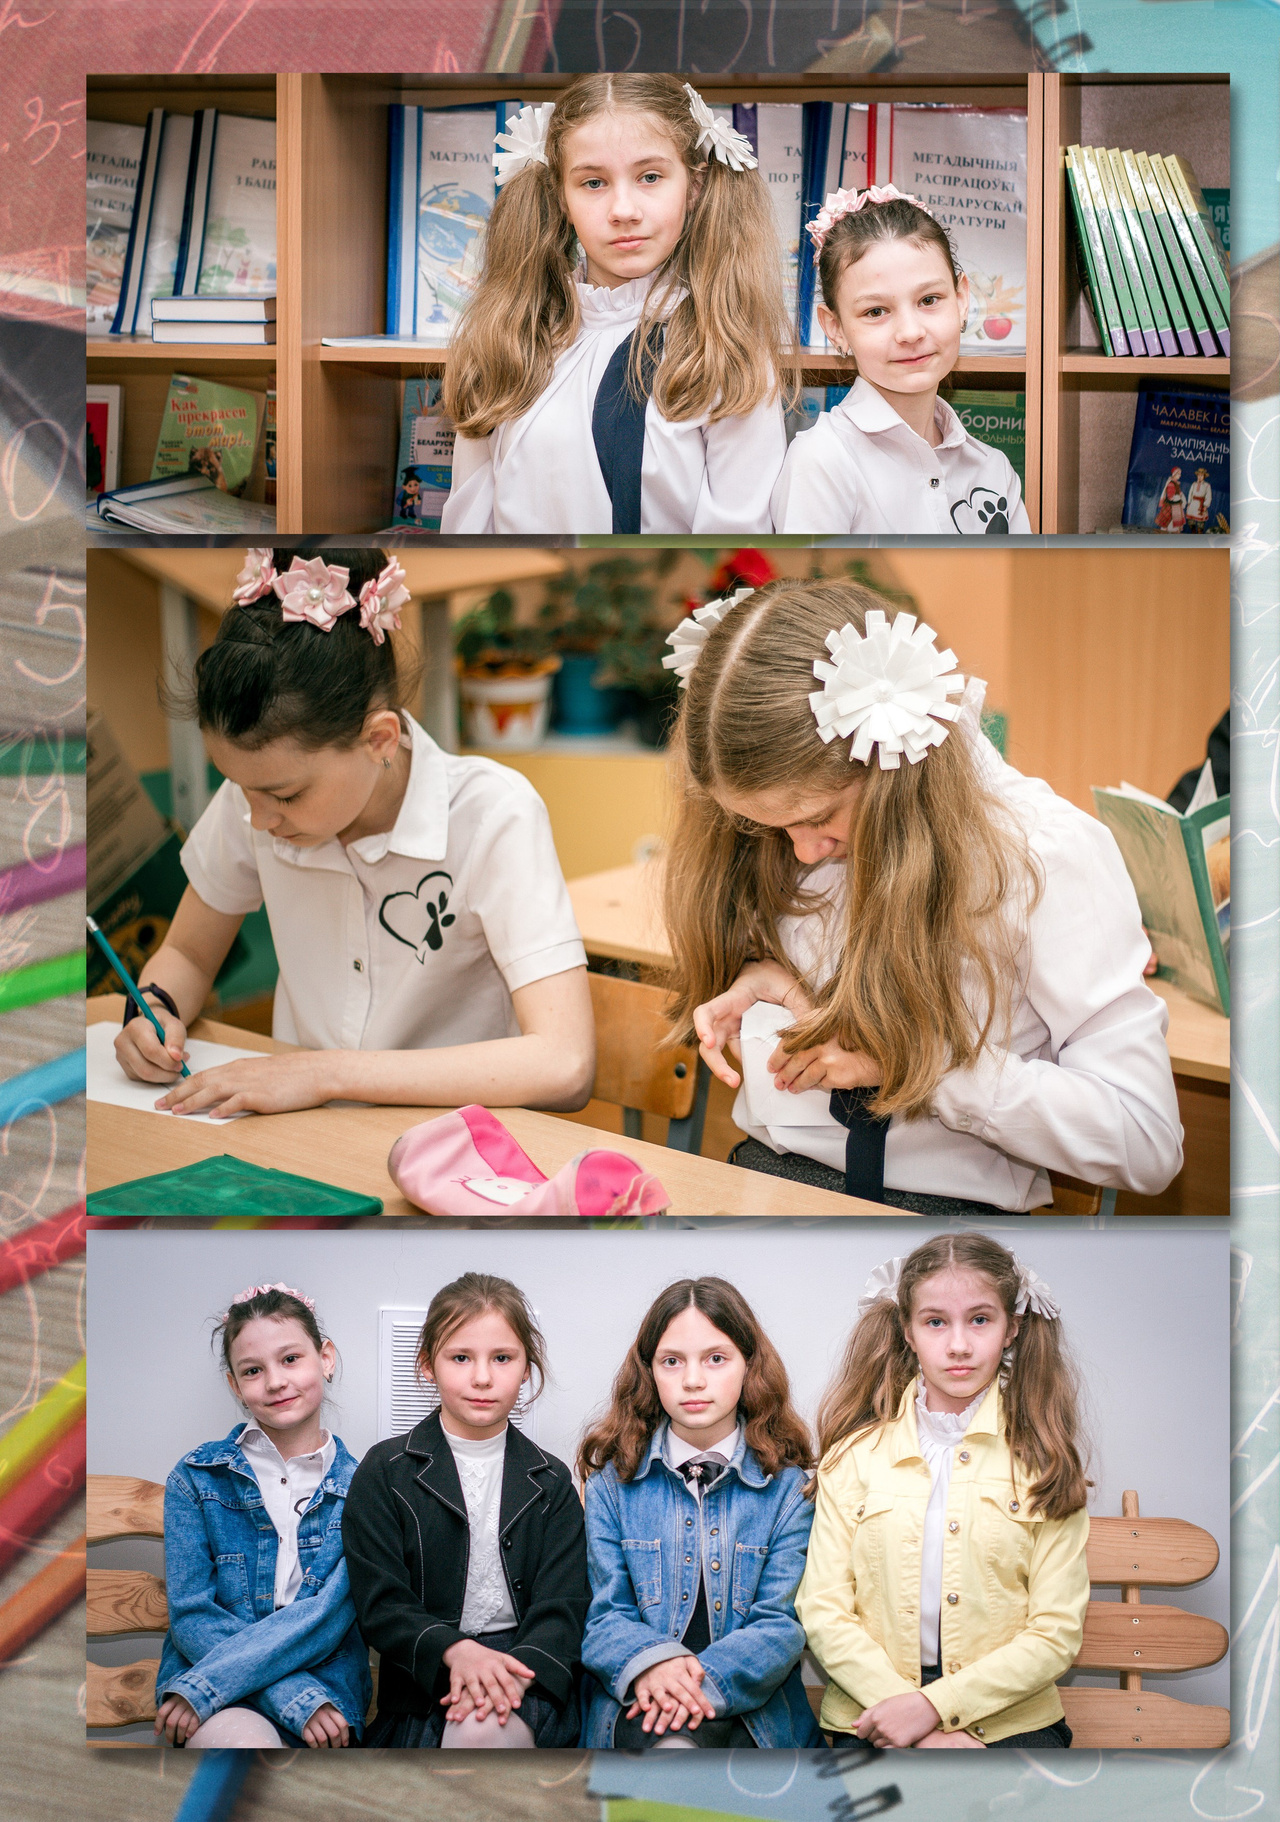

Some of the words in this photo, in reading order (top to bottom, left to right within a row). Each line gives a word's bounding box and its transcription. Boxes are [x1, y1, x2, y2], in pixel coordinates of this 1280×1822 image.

[913, 151, 1018, 172] МЕТАДЫЧНЫЯ
[768, 172, 788, 183] ПО
[915, 172, 1016, 193] РАСПРАЦОЎКІ
[928, 194, 1023, 214] БЕЛАРУСКАЙ
[170, 399, 198, 412] Как
[1152, 404, 1210, 423] ЧАЛАВЕК
[177, 409, 247, 425] прекрасен
[956, 408, 1026, 432] борни
[1170, 447, 1224, 464] ЗАДАННІ
